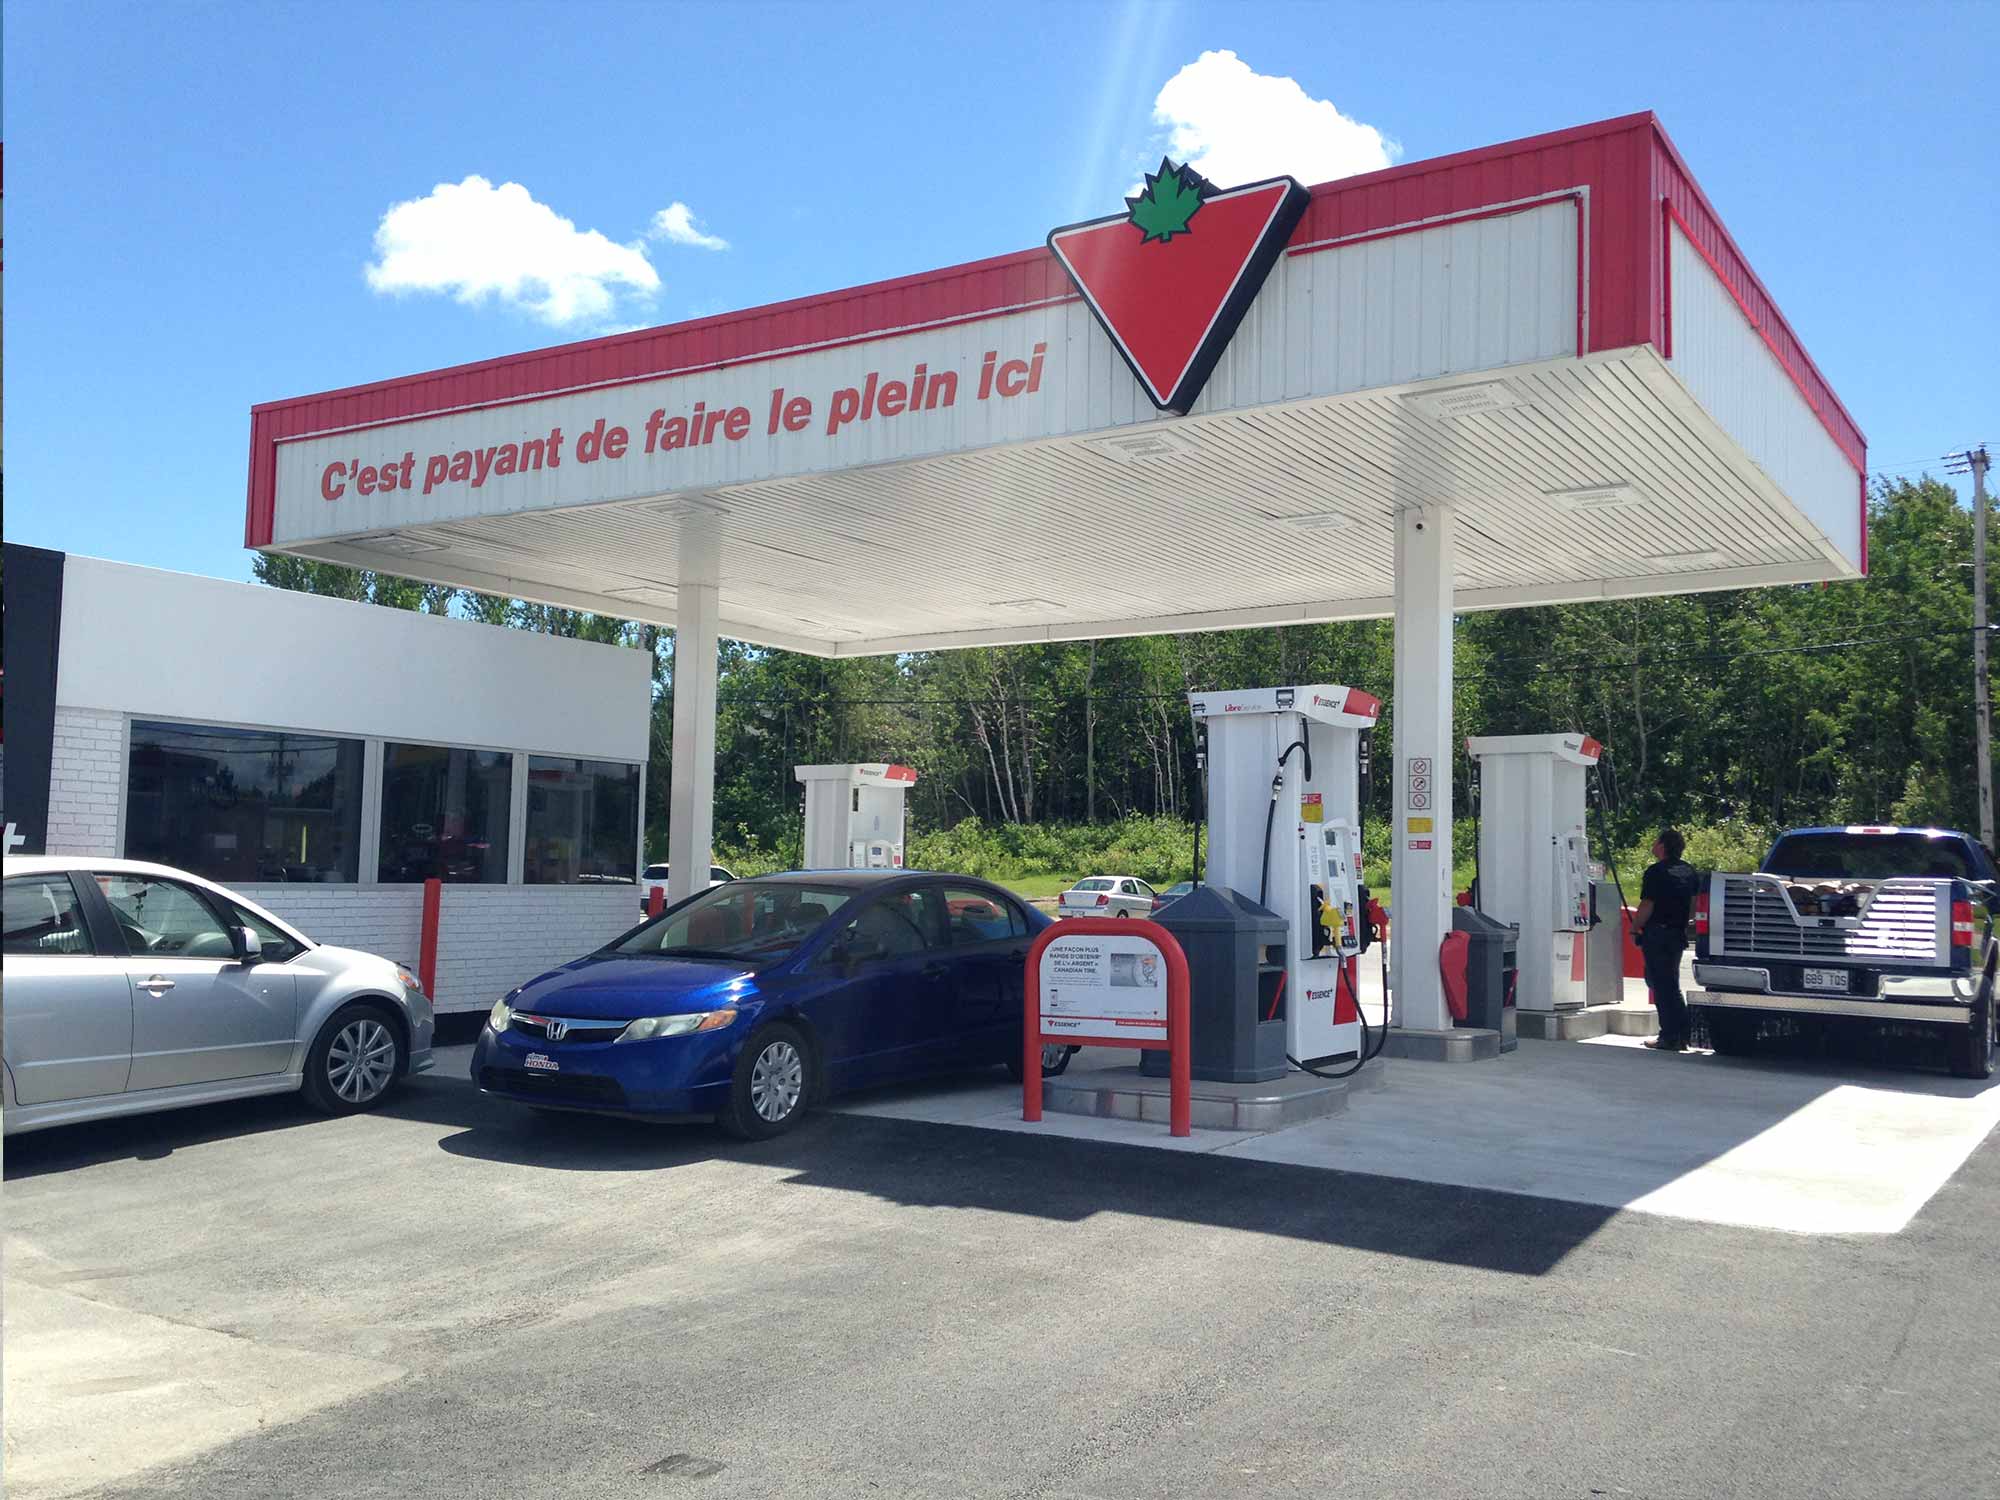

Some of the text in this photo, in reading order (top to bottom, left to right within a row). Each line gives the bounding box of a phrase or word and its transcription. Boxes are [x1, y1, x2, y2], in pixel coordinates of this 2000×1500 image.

[321, 342, 1047, 501] C'est payant de faire le plein ici
[1369, 703, 1376, 716] 4
